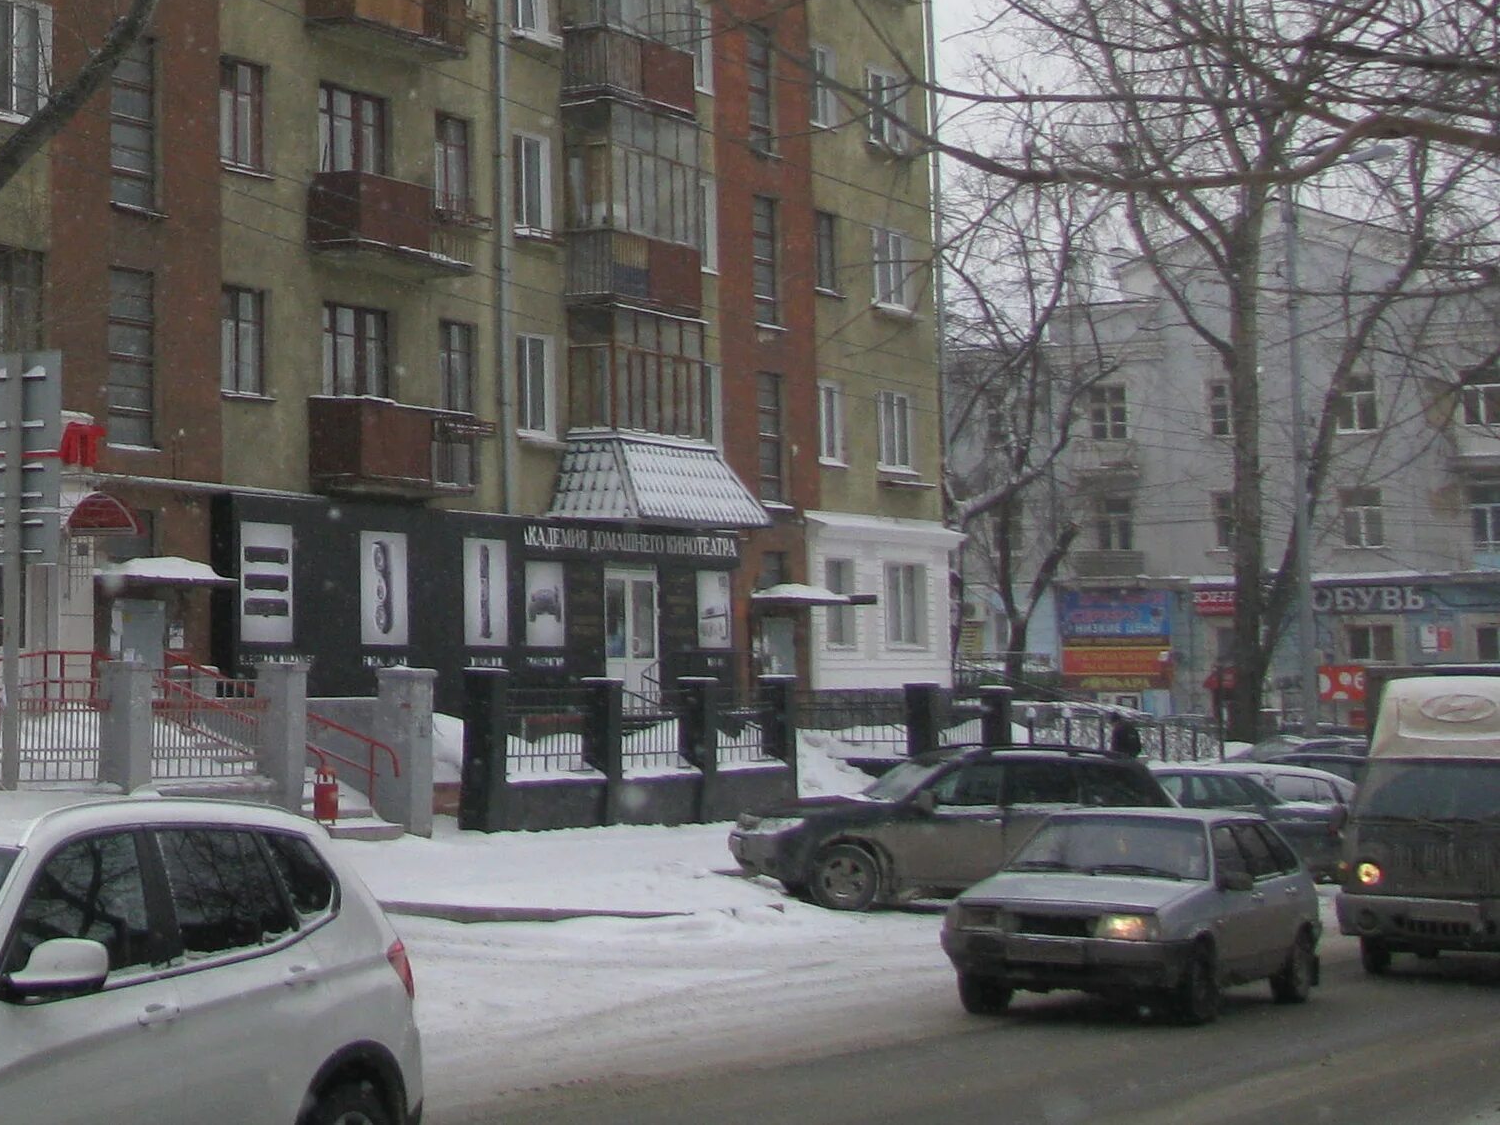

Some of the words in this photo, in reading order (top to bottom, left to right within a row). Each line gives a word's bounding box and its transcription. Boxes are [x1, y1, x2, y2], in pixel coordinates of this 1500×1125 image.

[590, 530, 665, 553] ДОМАШНЕГО
[666, 535, 738, 557] КИНОТЕАТРА
[1311, 586, 1424, 611] ОБУВЬ
